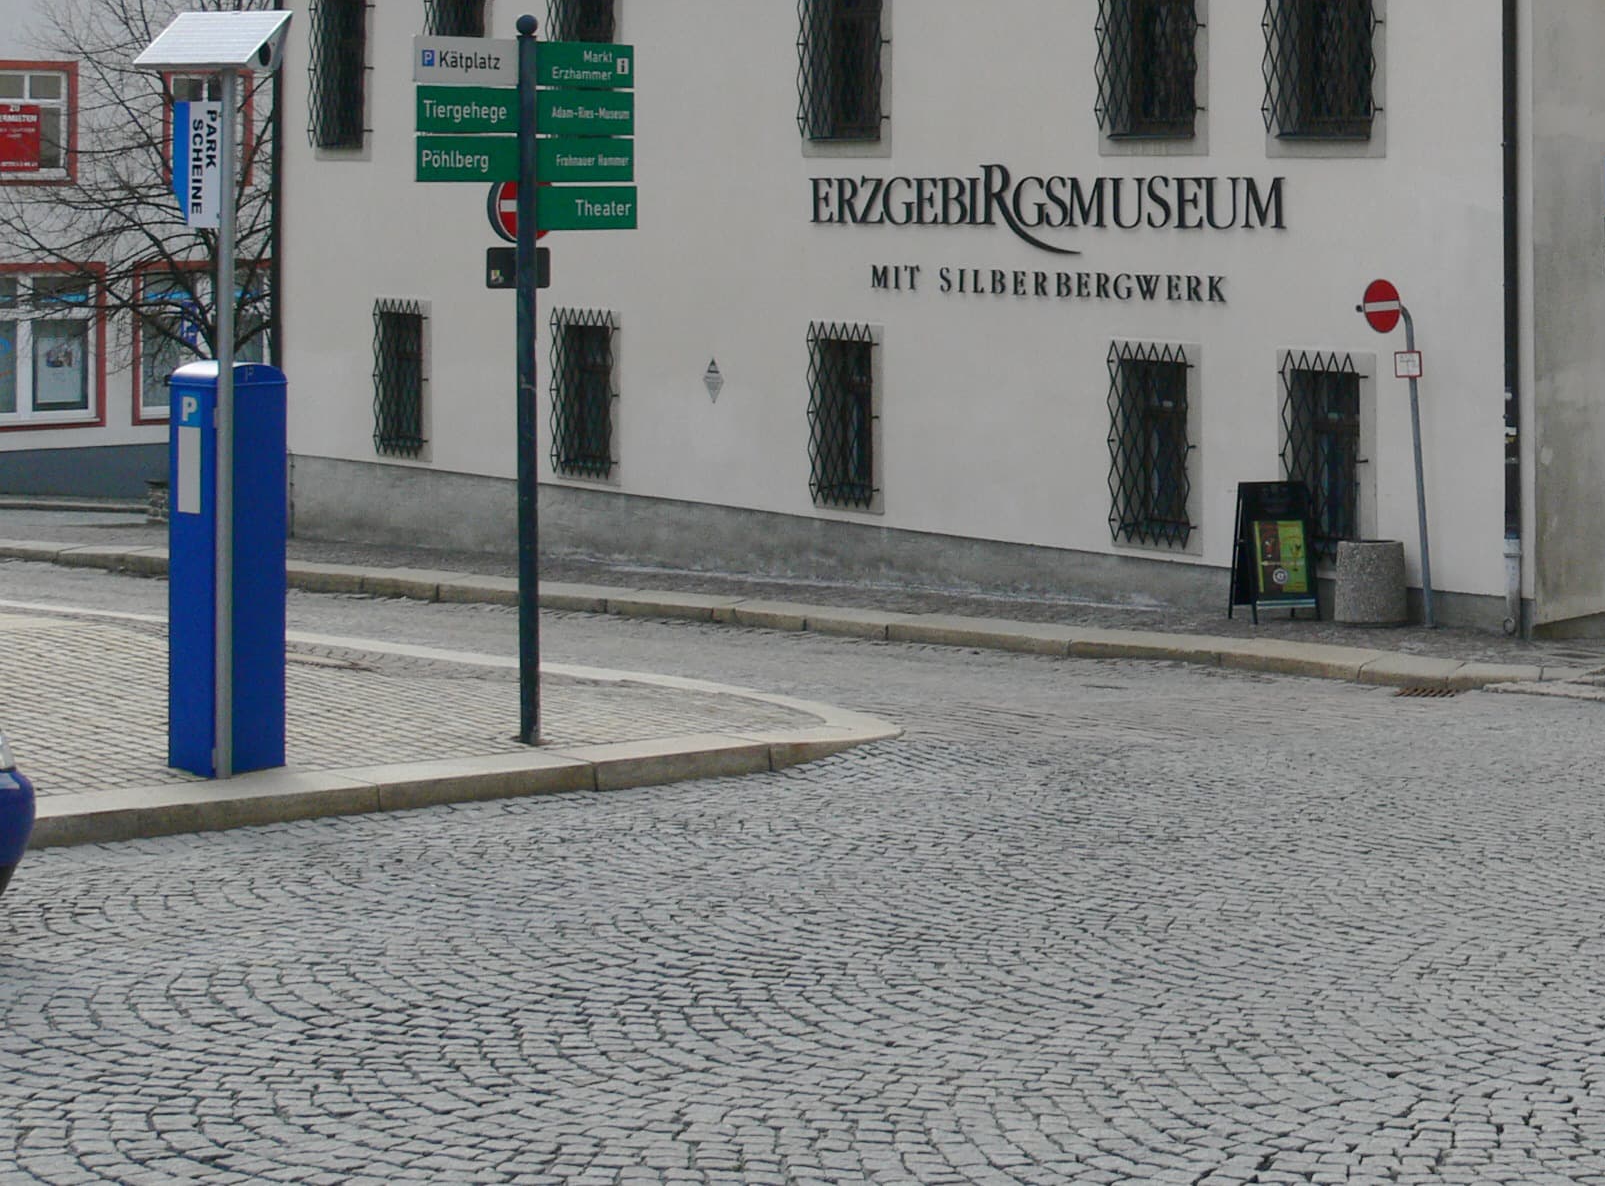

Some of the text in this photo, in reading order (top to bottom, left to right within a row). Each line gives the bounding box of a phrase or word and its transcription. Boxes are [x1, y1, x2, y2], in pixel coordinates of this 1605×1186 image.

[440, 51, 501, 73] Kätplatz
[583, 50, 613, 63] Markt
[551, 66, 613, 81] Erzhammer
[423, 99, 508, 123] Tiergehege
[206, 109, 218, 169] PARK
[191, 118, 204, 214] SCHEINE
[422, 150, 489, 173] Pöhlberg
[575, 199, 632, 216] Theater
[808, 164, 1287, 255] ERZGEBIRGSMUSEUM
[871, 264, 1227, 303] MIT SILBERBERGWERK
[182, 396, 197, 422] P
